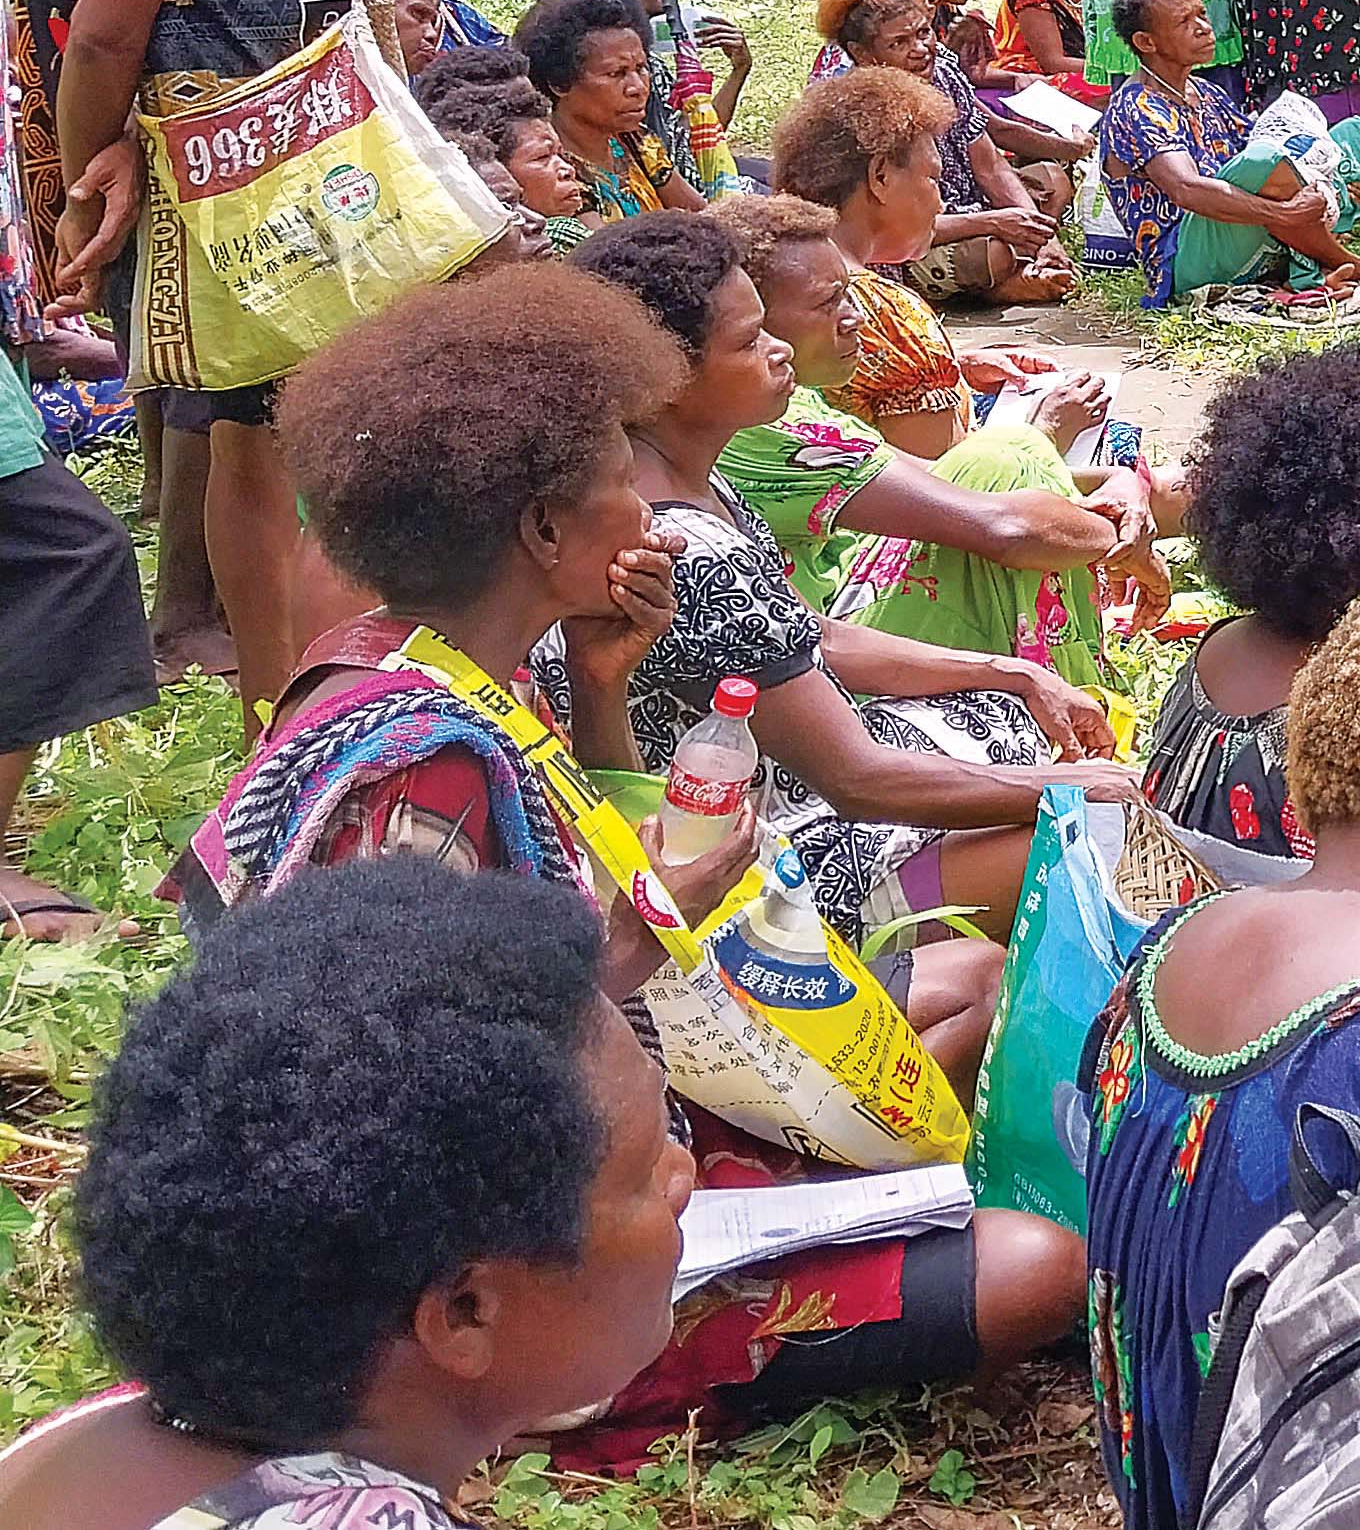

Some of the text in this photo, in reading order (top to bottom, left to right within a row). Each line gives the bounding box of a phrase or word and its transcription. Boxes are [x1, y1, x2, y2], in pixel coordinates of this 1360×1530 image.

[670, 771, 729, 805] Coca-Cola
[736, 961, 830, 1002] 缓释长效
